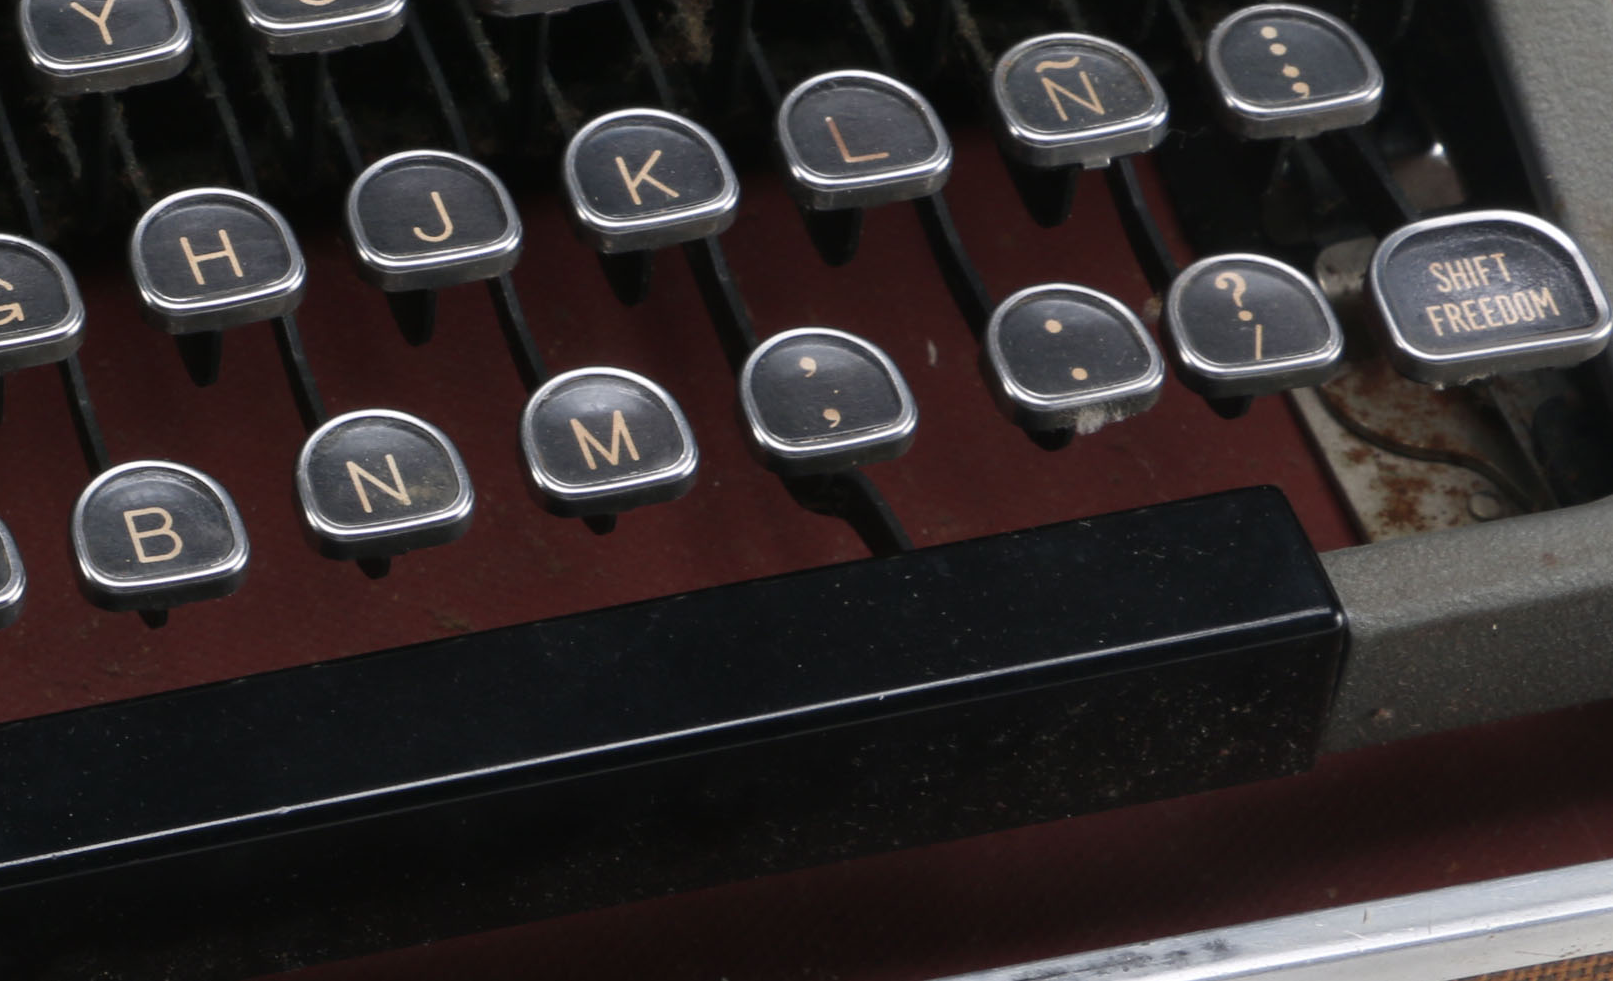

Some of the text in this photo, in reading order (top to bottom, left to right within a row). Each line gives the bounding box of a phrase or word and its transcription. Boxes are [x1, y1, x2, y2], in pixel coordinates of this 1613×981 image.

[1035, 55, 1106, 121] Ñ
[825, 116, 890, 164] L
[614, 149, 680, 206] K
[412, 190, 454, 243] J
[179, 228, 244, 285] H
[1428, 251, 1512, 293] SHIFT
[1214, 270, 1254, 322] ?
[1425, 286, 1560, 337] FREEDOM
[569, 409, 640, 470] M
[345, 453, 412, 514] N
[122, 506, 184, 564] B
